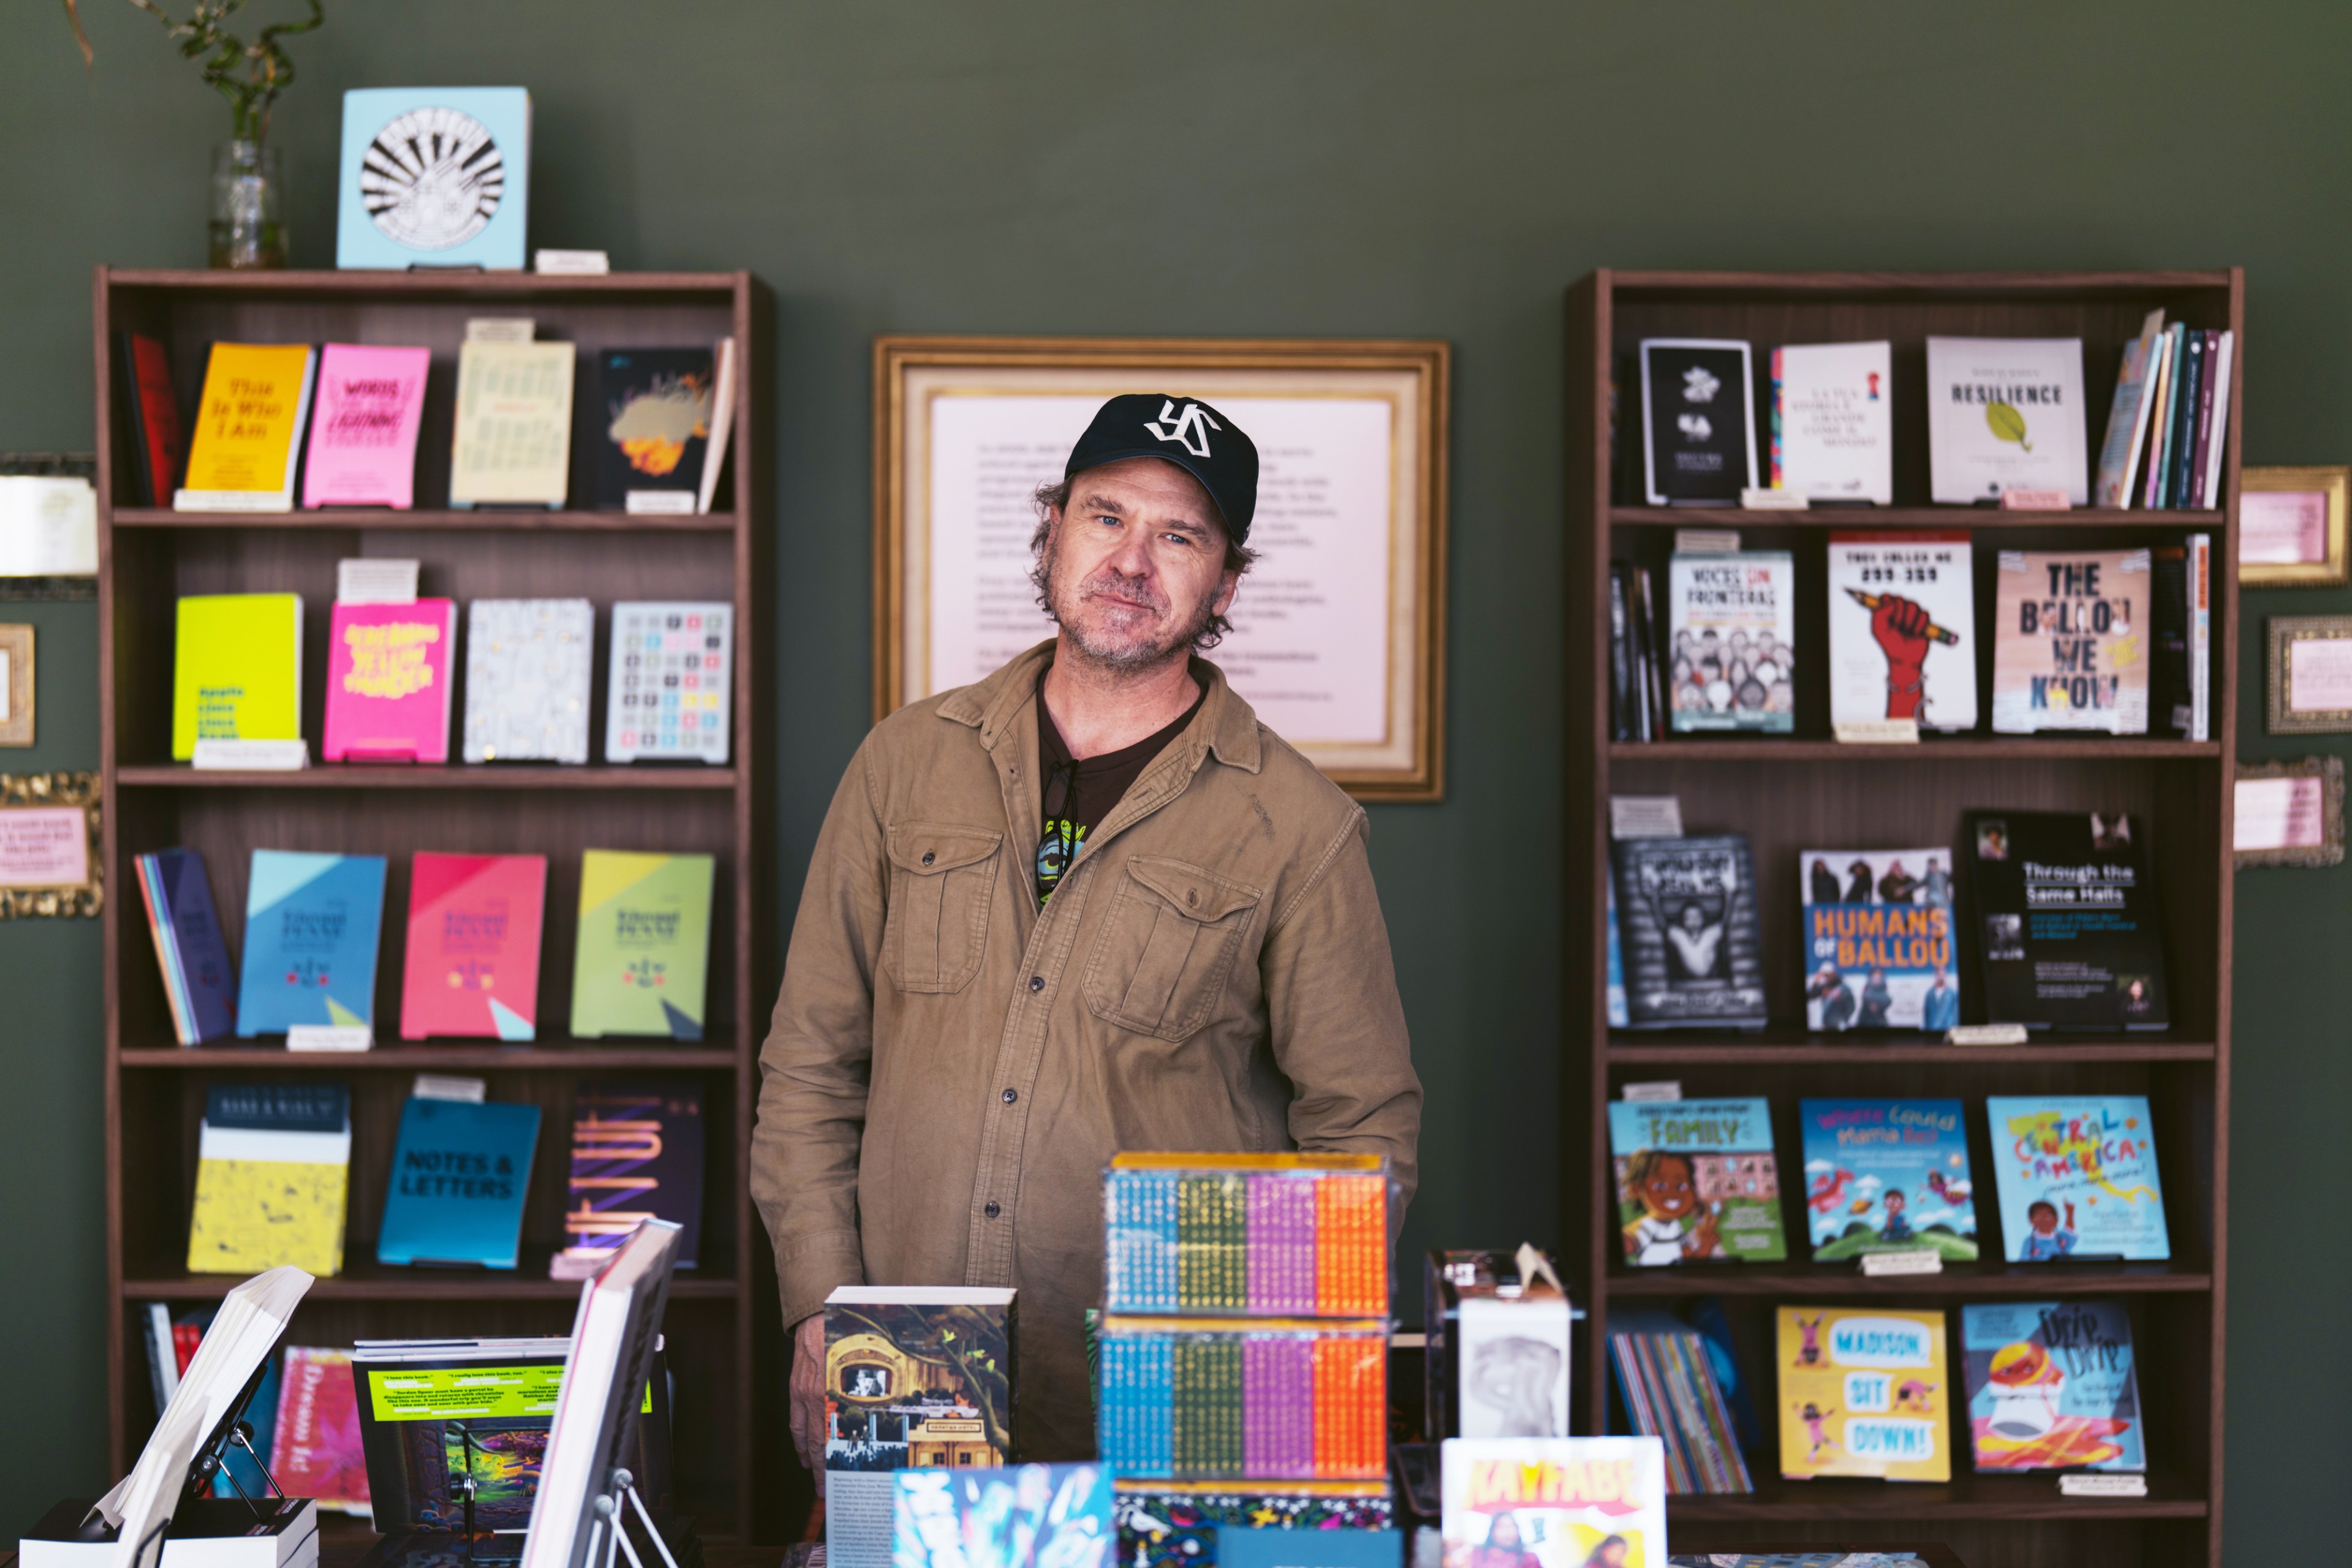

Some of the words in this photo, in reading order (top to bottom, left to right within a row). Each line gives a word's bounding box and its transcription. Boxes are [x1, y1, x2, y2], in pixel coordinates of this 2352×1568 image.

[1951, 383, 2063, 406] RESILIENCE
[2047, 562, 2101, 597] THE
[2052, 639, 2098, 672] WE
[2030, 674, 2119, 710] KNOW
[2023, 862, 2099, 884] Through
[2102, 864, 2135, 881] the
[2025, 885, 2076, 903] Same
[1813, 908, 1949, 939] HUMANS
[1837, 937, 1951, 968] BALLOU
[1649, 1118, 1739, 1145] FAMILY
[404, 1148, 490, 1175] NOTES
[496, 1154, 515, 1176] &
[399, 1172, 514, 1200] LETTERS
[1835, 1329, 1928, 1360] MADISON,
[1849, 1376, 1886, 1405] SIT
[1853, 1423, 1927, 1454] DOWN!
